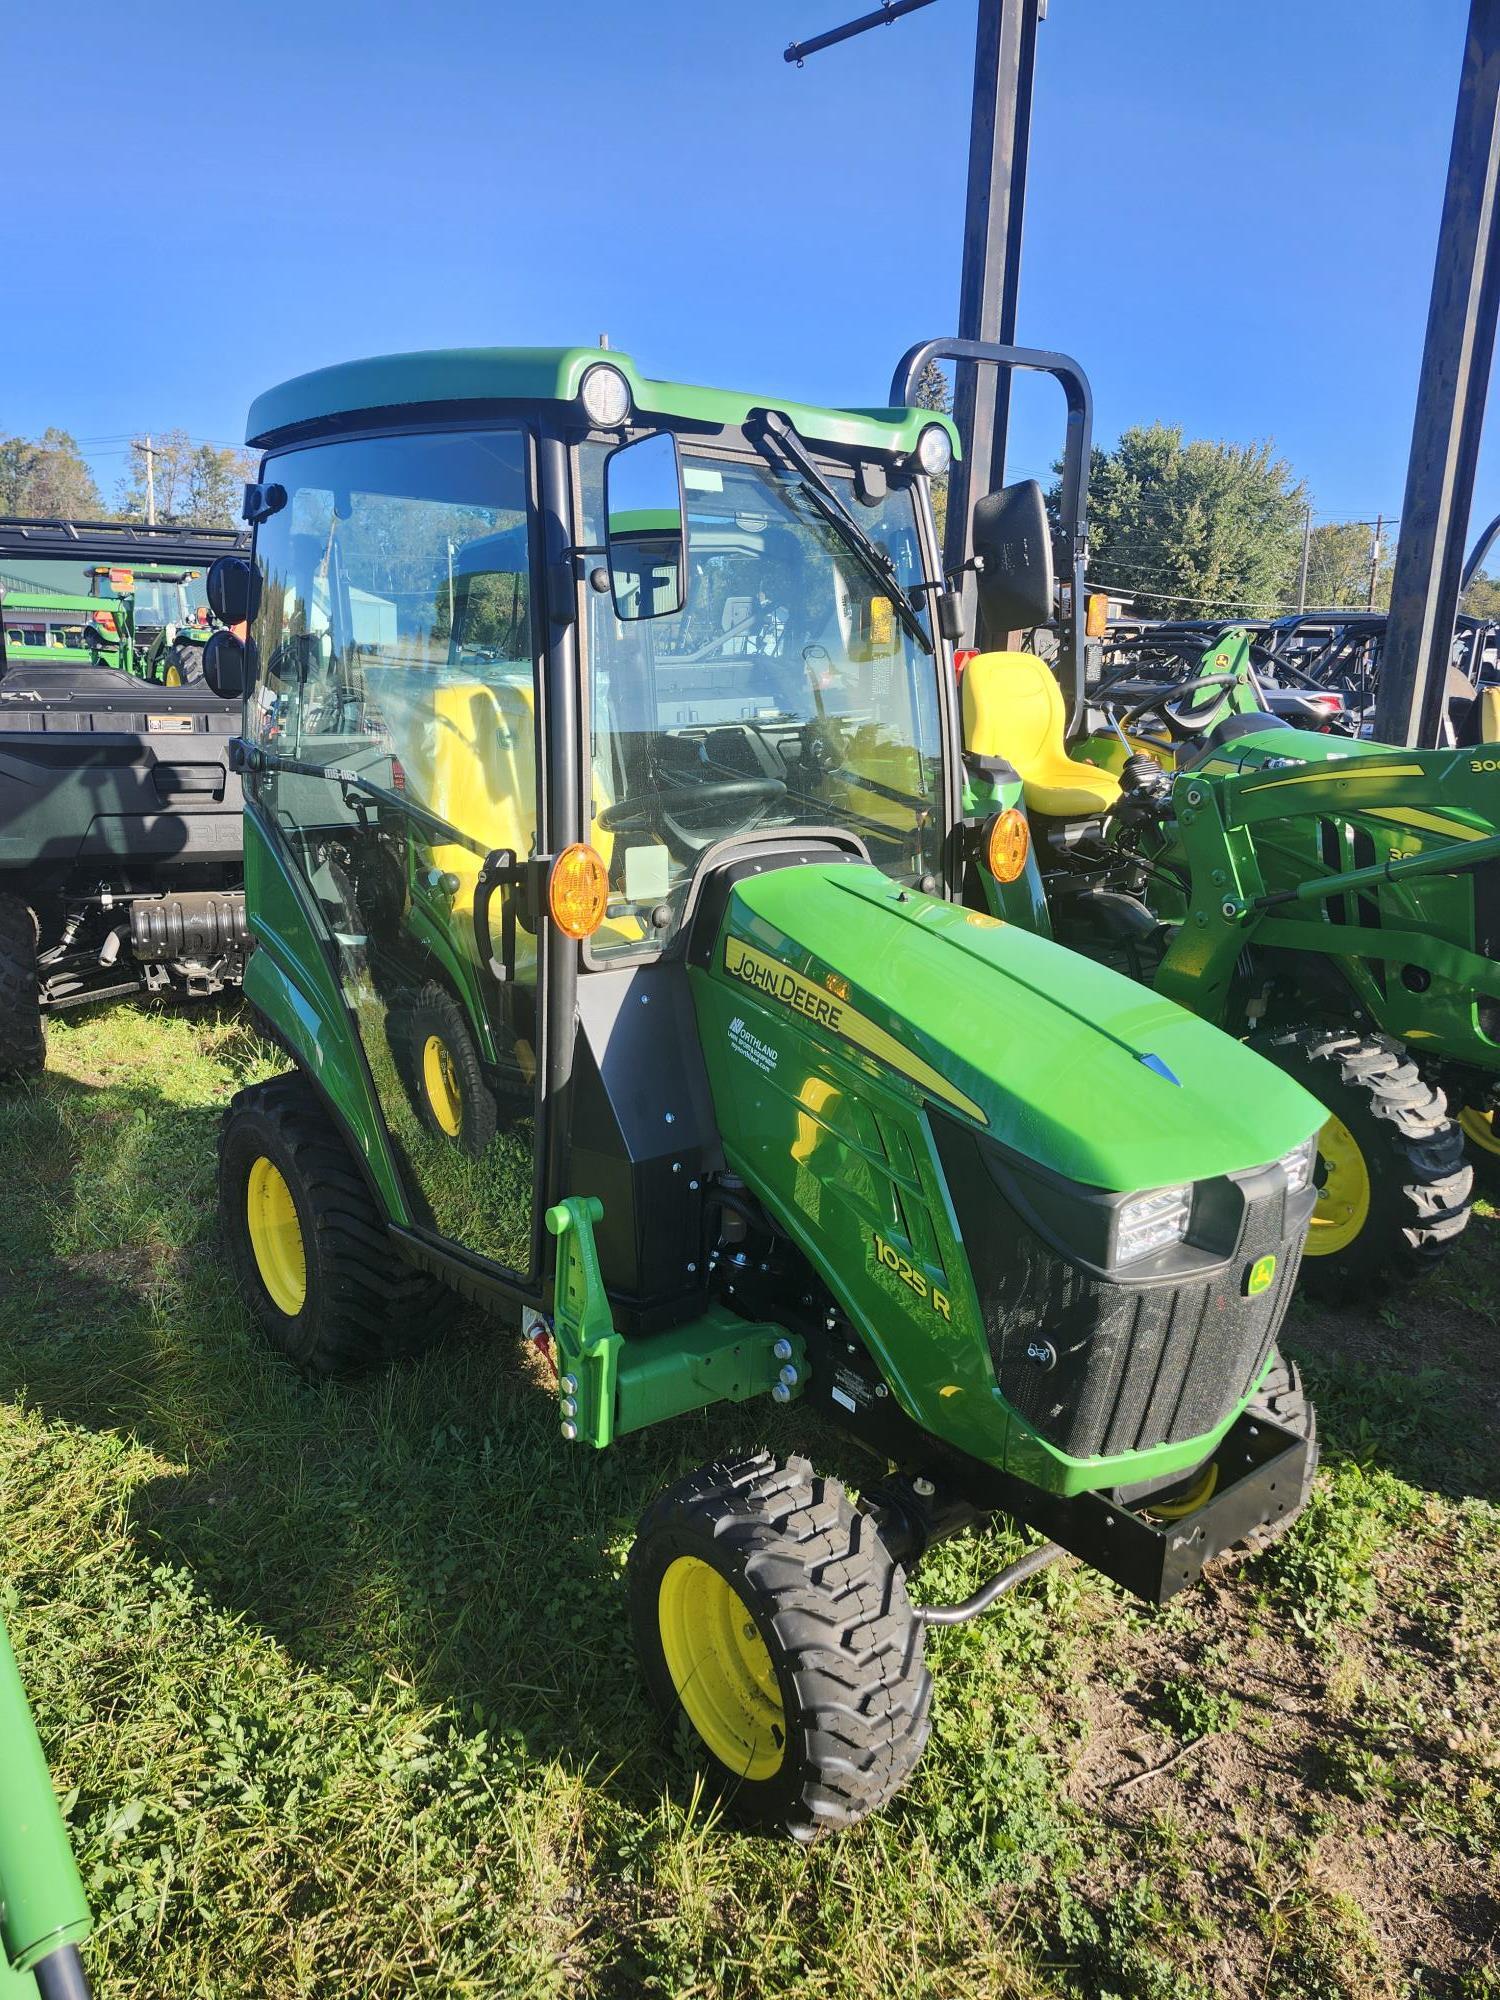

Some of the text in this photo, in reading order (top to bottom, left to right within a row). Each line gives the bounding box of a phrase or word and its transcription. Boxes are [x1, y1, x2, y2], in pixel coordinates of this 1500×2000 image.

[1469, 759, 1500, 773] 30
[733, 952, 844, 1031] JOHN DEERE
[729, 1016, 778, 1061] NORTHLAND
[873, 1232, 951, 1322] 1025 R
